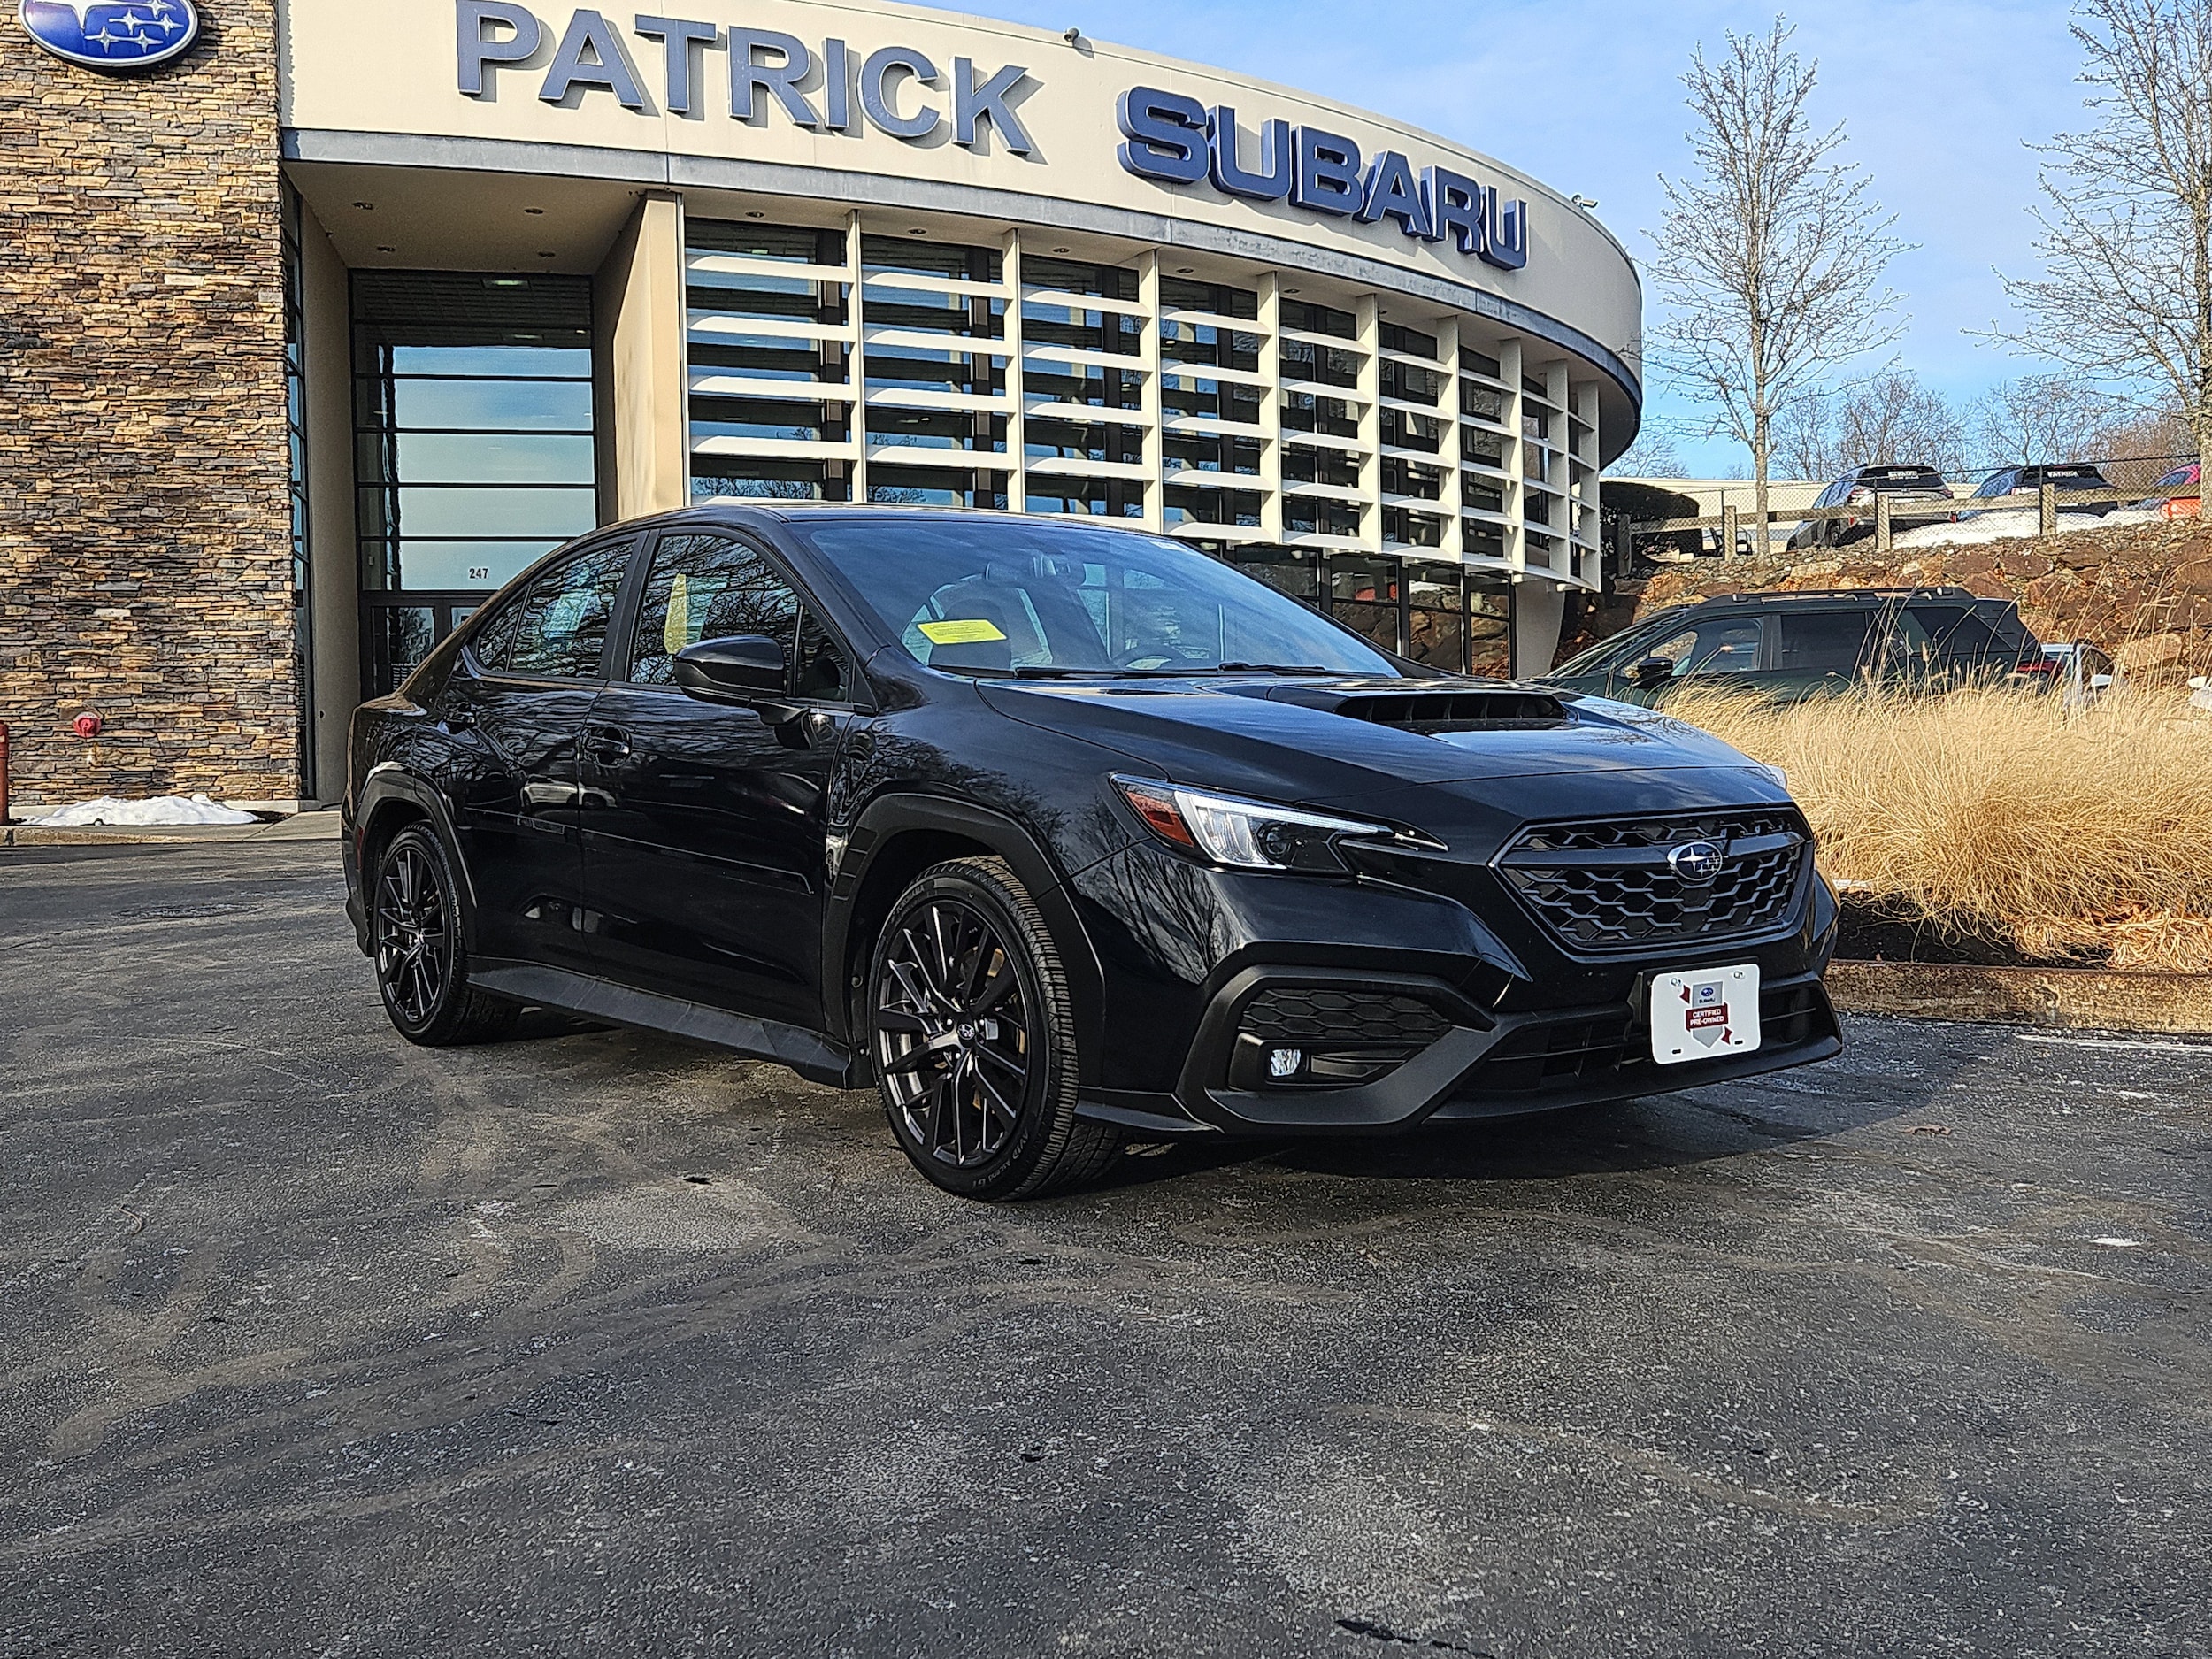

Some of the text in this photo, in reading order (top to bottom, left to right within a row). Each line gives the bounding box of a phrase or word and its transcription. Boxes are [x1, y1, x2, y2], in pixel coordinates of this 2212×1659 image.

[457, 0, 1529, 271] PATRICK SUBARU
[469, 567, 489, 580] 247
[1692, 1009, 1722, 1018] CERTIFIED
[1689, 1016, 1724, 1026] PRE-OWNED
